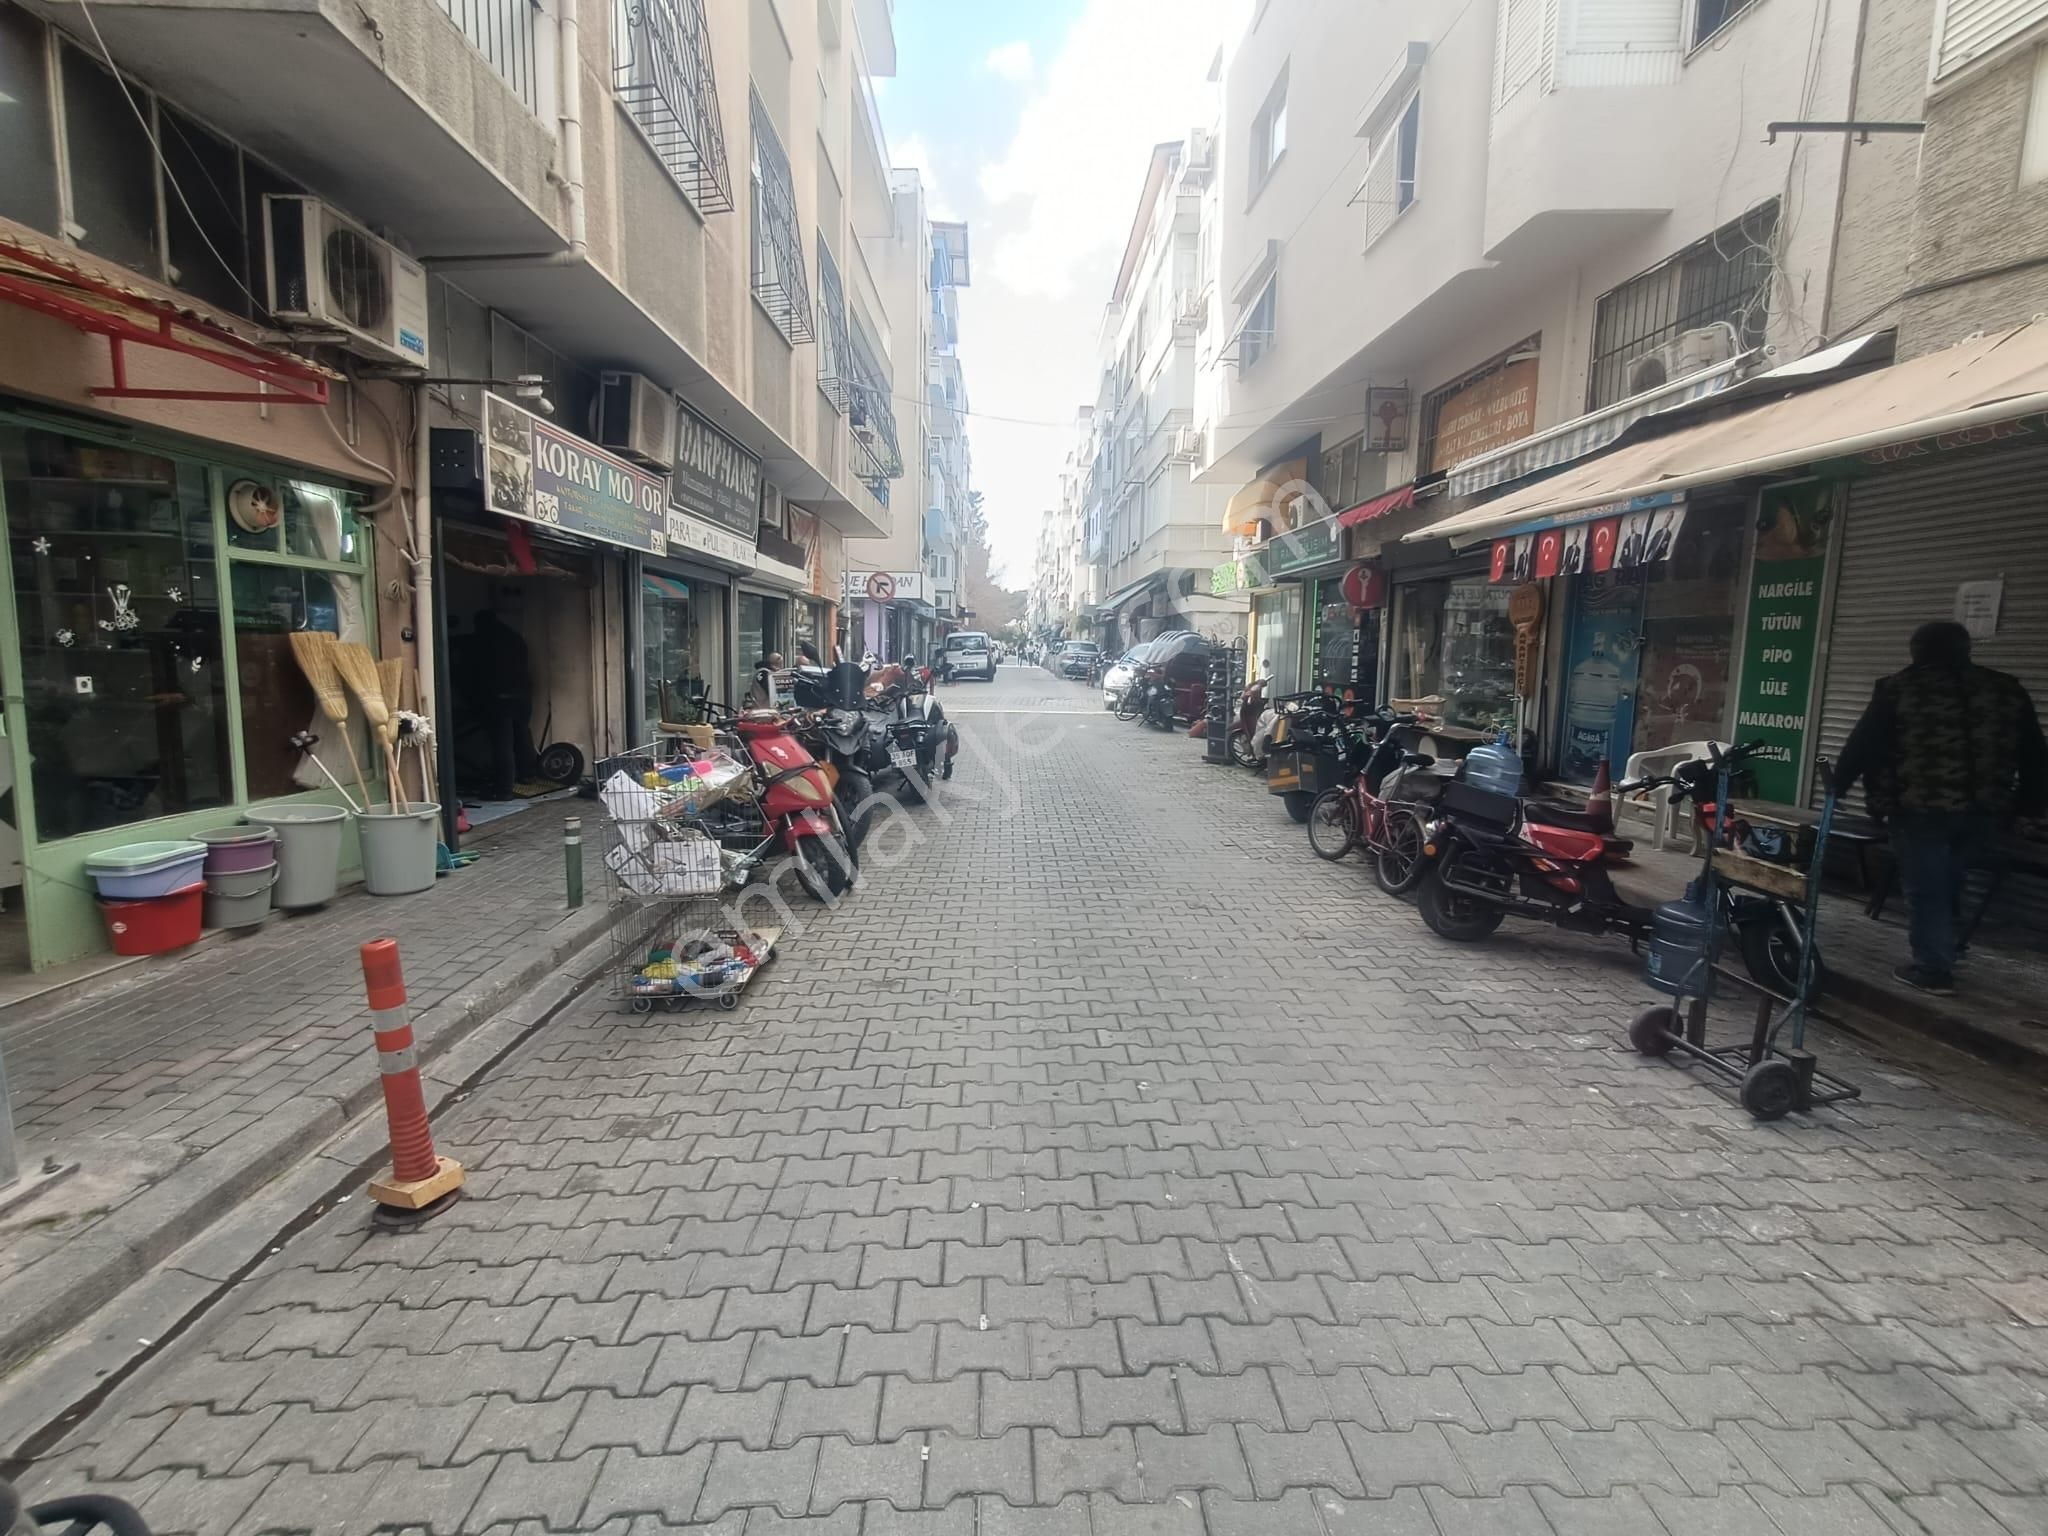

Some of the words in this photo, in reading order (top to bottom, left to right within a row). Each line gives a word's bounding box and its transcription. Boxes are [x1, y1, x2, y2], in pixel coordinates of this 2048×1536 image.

[1506, 410, 1529, 431] BOYA
[679, 412, 757, 502] DARPHANE
[536, 435, 602, 491] KORAY
[607, 469, 662, 516] MOTOR
[670, 517, 691, 543] PARA
[707, 531, 721, 553] PUL
[1758, 578, 1814, 599] NARGİLE
[1761, 612, 1802, 631] TÜTÜN
[1762, 645, 1793, 664] PİPO
[1760, 677, 1788, 696] LÜLE
[1739, 711, 1804, 731] MAKARON
[1743, 742, 1792, 762] BAKA
